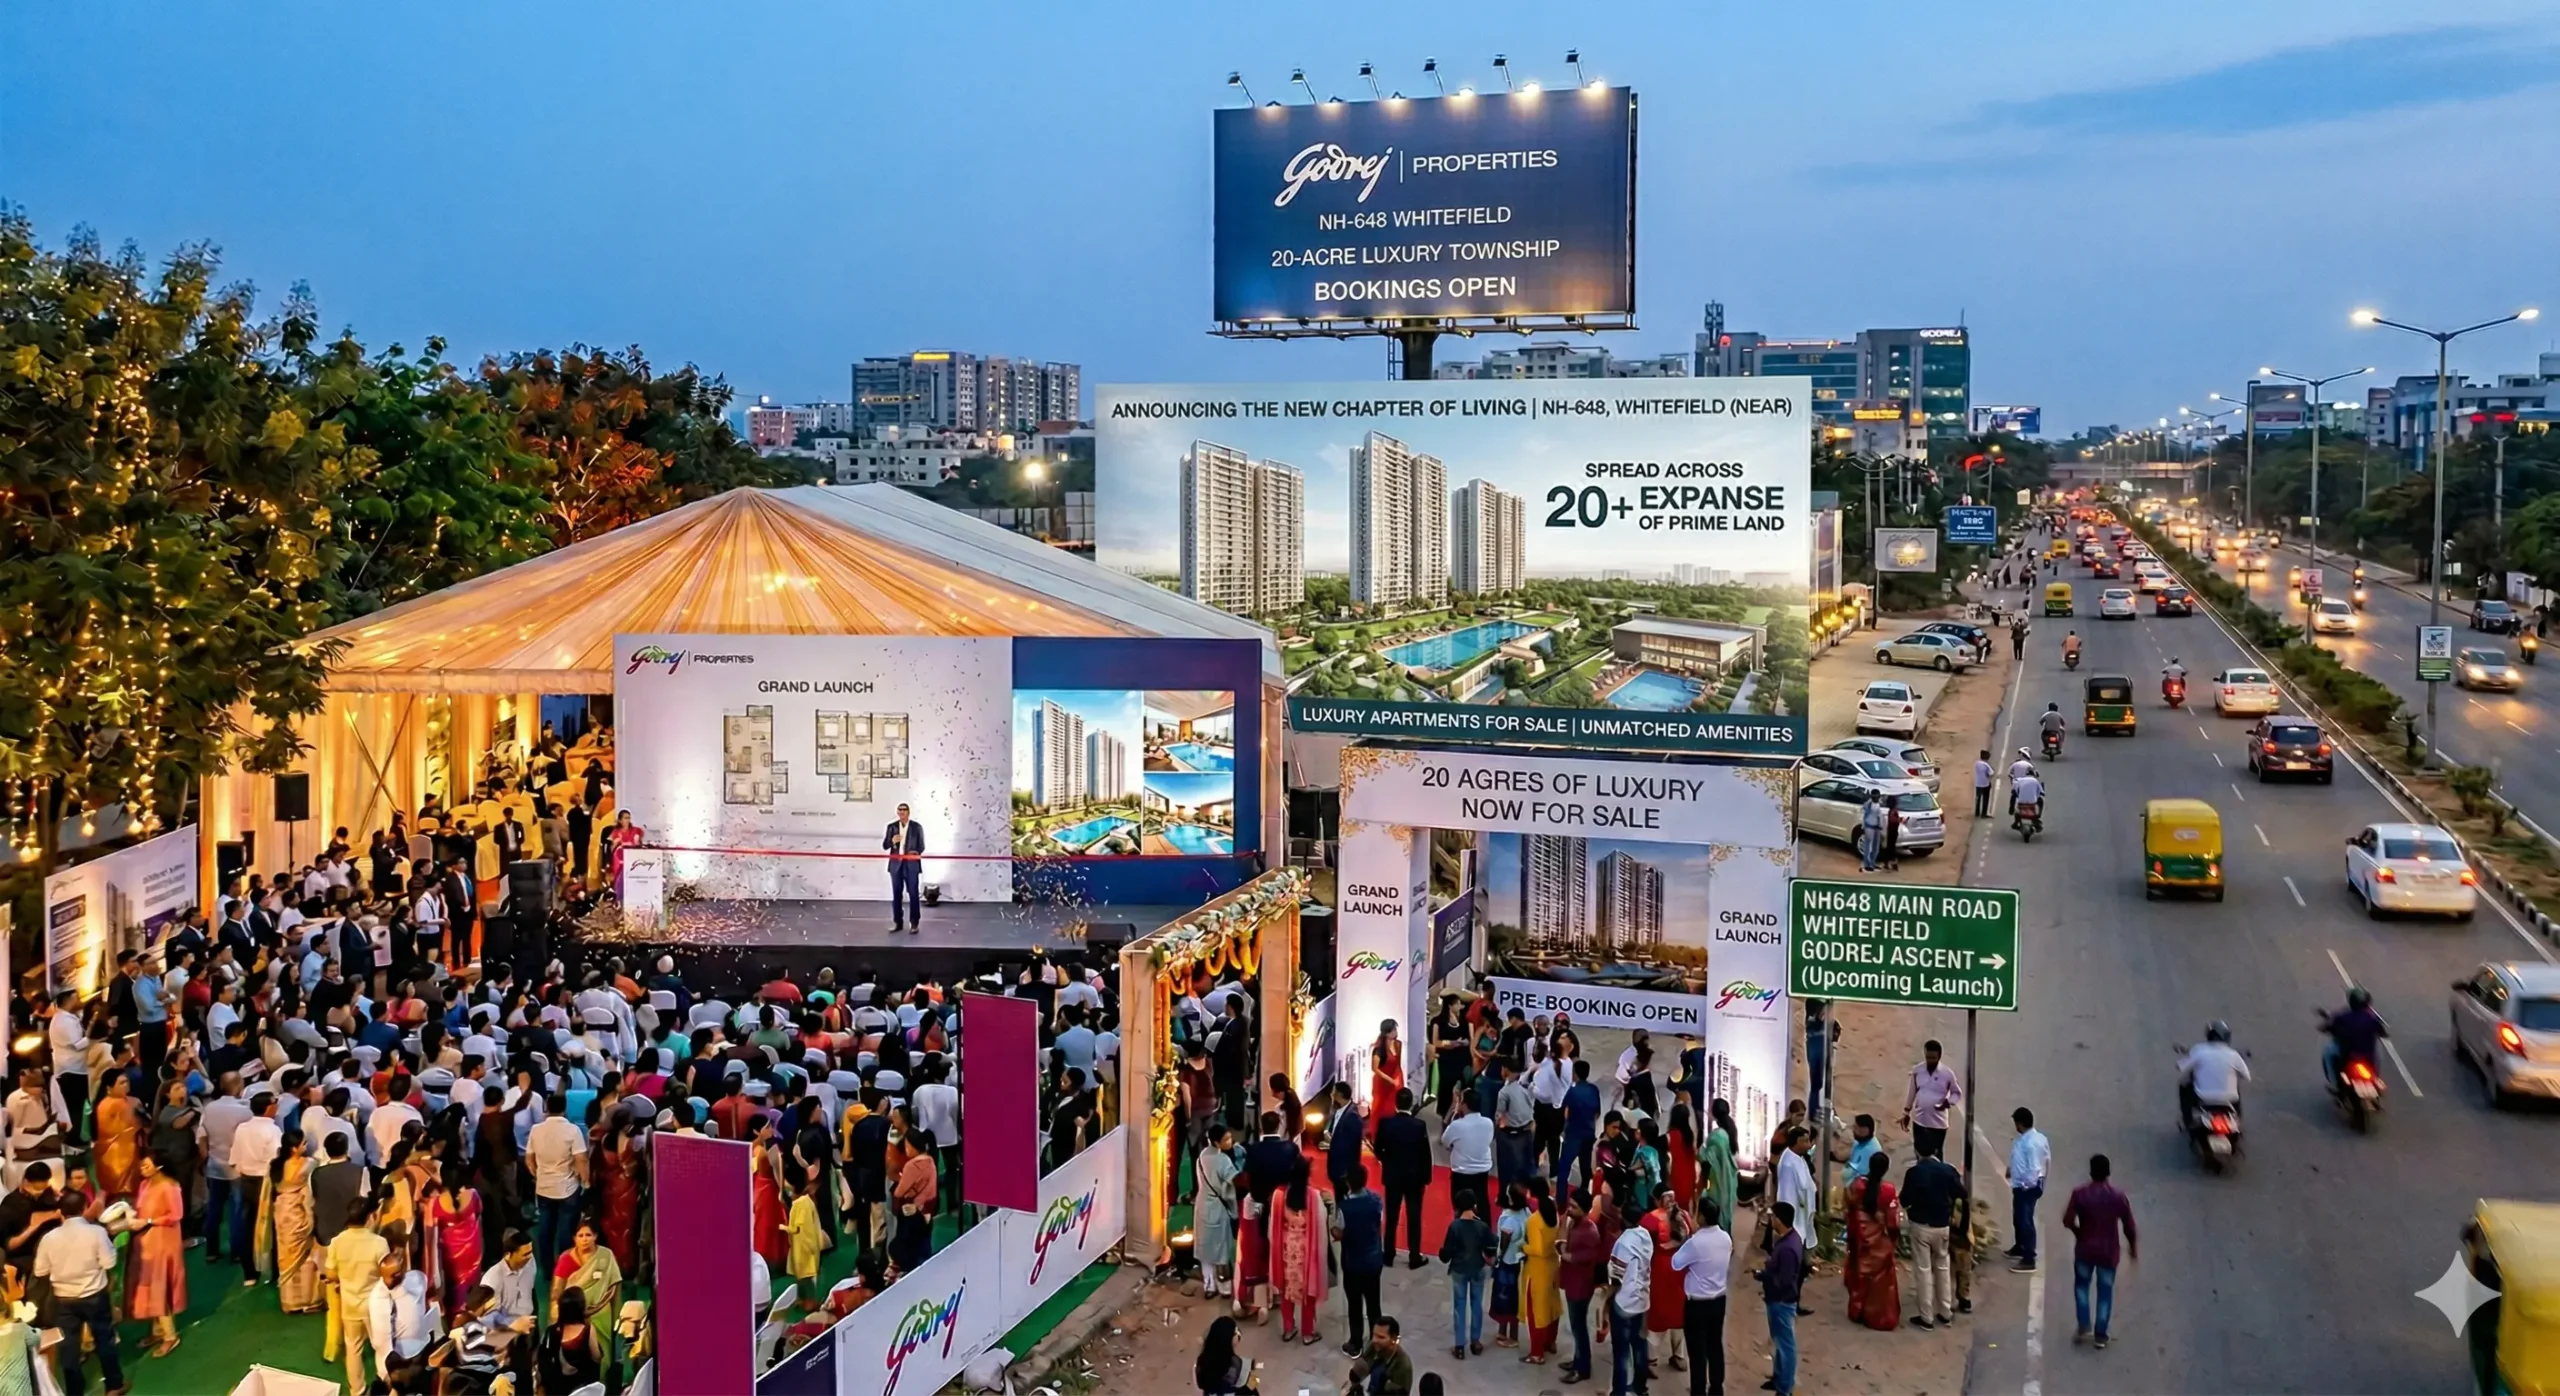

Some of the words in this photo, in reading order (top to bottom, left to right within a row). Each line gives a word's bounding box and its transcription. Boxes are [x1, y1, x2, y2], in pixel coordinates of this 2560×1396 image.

[1274, 142, 1394, 207] Godrej
[1412, 150, 1558, 174] PROPERTIES
[1319, 212, 1387, 230] NH-648
[1393, 206, 1511, 227] WHITEFIELD
[1271, 248, 1356, 267] 20-ACRE
[1362, 244, 1442, 264] LUXURY
[1449, 239, 1560, 261] TOWNSHIP
[1314, 279, 1441, 301] BOOKINGS
[1448, 276, 1516, 297] OPEN
[1111, 401, 1237, 418] ANNOUNCING
[1242, 401, 1279, 417] THE
[1284, 400, 1327, 417] NEW
[1332, 400, 1423, 417] CHAPTER
[1429, 399, 1457, 416] OF
[1462, 399, 1526, 416] LIVING
[1542, 399, 1610, 419] NH-648,
[1616, 398, 1726, 415] WHITEFIELD
[1730, 398, 1792, 418] (NEAR)
[1585, 463, 1660, 478] SPREAD
[1665, 463, 1743, 478] ACROSS
[1545, 485, 1634, 528] 20+
[1640, 486, 1785, 510] EXPANSE
[1639, 516, 1664, 530] OF
[1669, 516, 1728, 530] PRIME
[1733, 516, 1785, 531] LAND
[626, 645, 687, 675] Godrej
[694, 654, 754, 664] PROPERTIES
[758, 680, 810, 693] GRAND
[814, 681, 873, 693] LAUNCH
[1302, 708, 1366, 724] LUXURY
[1370, 710, 1480, 729] APARTMENTS
[1485, 715, 1519, 730] FOR
[1524, 717, 1567, 733] SALE
[1581, 719, 1691, 738] UNMATCHED
[1696, 724, 1793, 743] AMENITIES
[1422, 767, 1449, 788] 20
[1552, 773, 1587, 796] OF
[1596, 775, 1705, 802] LUXURY
[1462, 798, 1523, 820] NOW
[1532, 802, 1584, 825] FOR
[1592, 805, 1661, 829] SALE
[1348, 884, 1399, 899] GRAND
[1803, 890, 1871, 912] NH648
[1878, 894, 1932, 916] MAIN
[1942, 898, 2002, 920] ROAD
[1344, 900, 1403, 917] LAUNCH
[1720, 910, 1777, 926] GRAND
[1716, 928, 1782, 945] LAUNCH
[1802, 915, 1930, 941] WHITEFIELD
[1341, 951, 1403, 982] Godrej
[1801, 940, 1884, 964] GODREJ
[1890, 946, 1975, 970] ASCENT
[1714, 980, 1782, 1012] Godrej
[1801, 965, 1911, 996] (Upcoming
[1920, 973, 2003, 1002] Launch)
[1500, 990, 1636, 1018] PRE-BOOKING
[1642, 1006, 1698, 1024] OPEN
[1030, 1178, 1098, 1285] Godrej
[883, 1277, 966, 1396] Godrej
